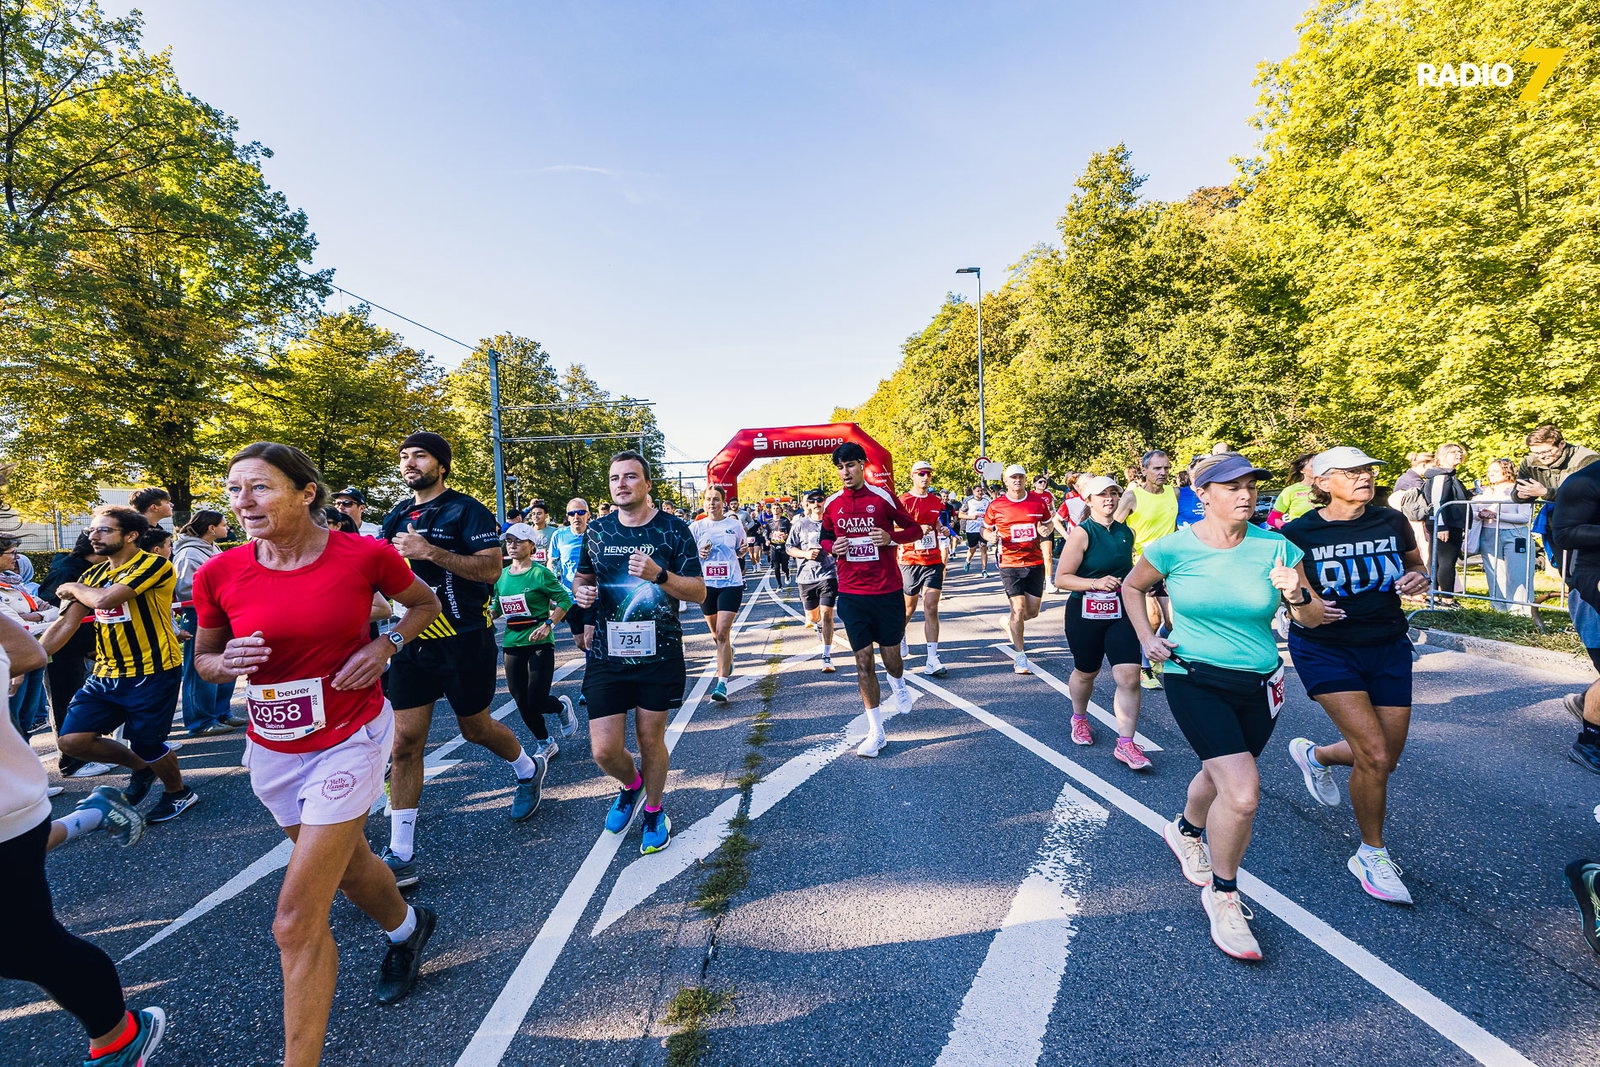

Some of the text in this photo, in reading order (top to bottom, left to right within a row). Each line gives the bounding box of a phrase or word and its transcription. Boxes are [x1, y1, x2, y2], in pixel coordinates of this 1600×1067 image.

[773, 437, 844, 450] Finanzgruppe
[837, 517, 875, 529] QATAR
[850, 545, 874, 554] 27178
[1311, 536, 1398, 561] wanzl
[708, 567, 725, 575] 8113
[1315, 553, 1405, 597] RUN
[503, 603, 521, 612] 5928
[1090, 602, 1115, 611] 5088
[619, 634, 642, 646] 734
[277, 687, 310, 698] beurer
[253, 703, 302, 723] 2958
